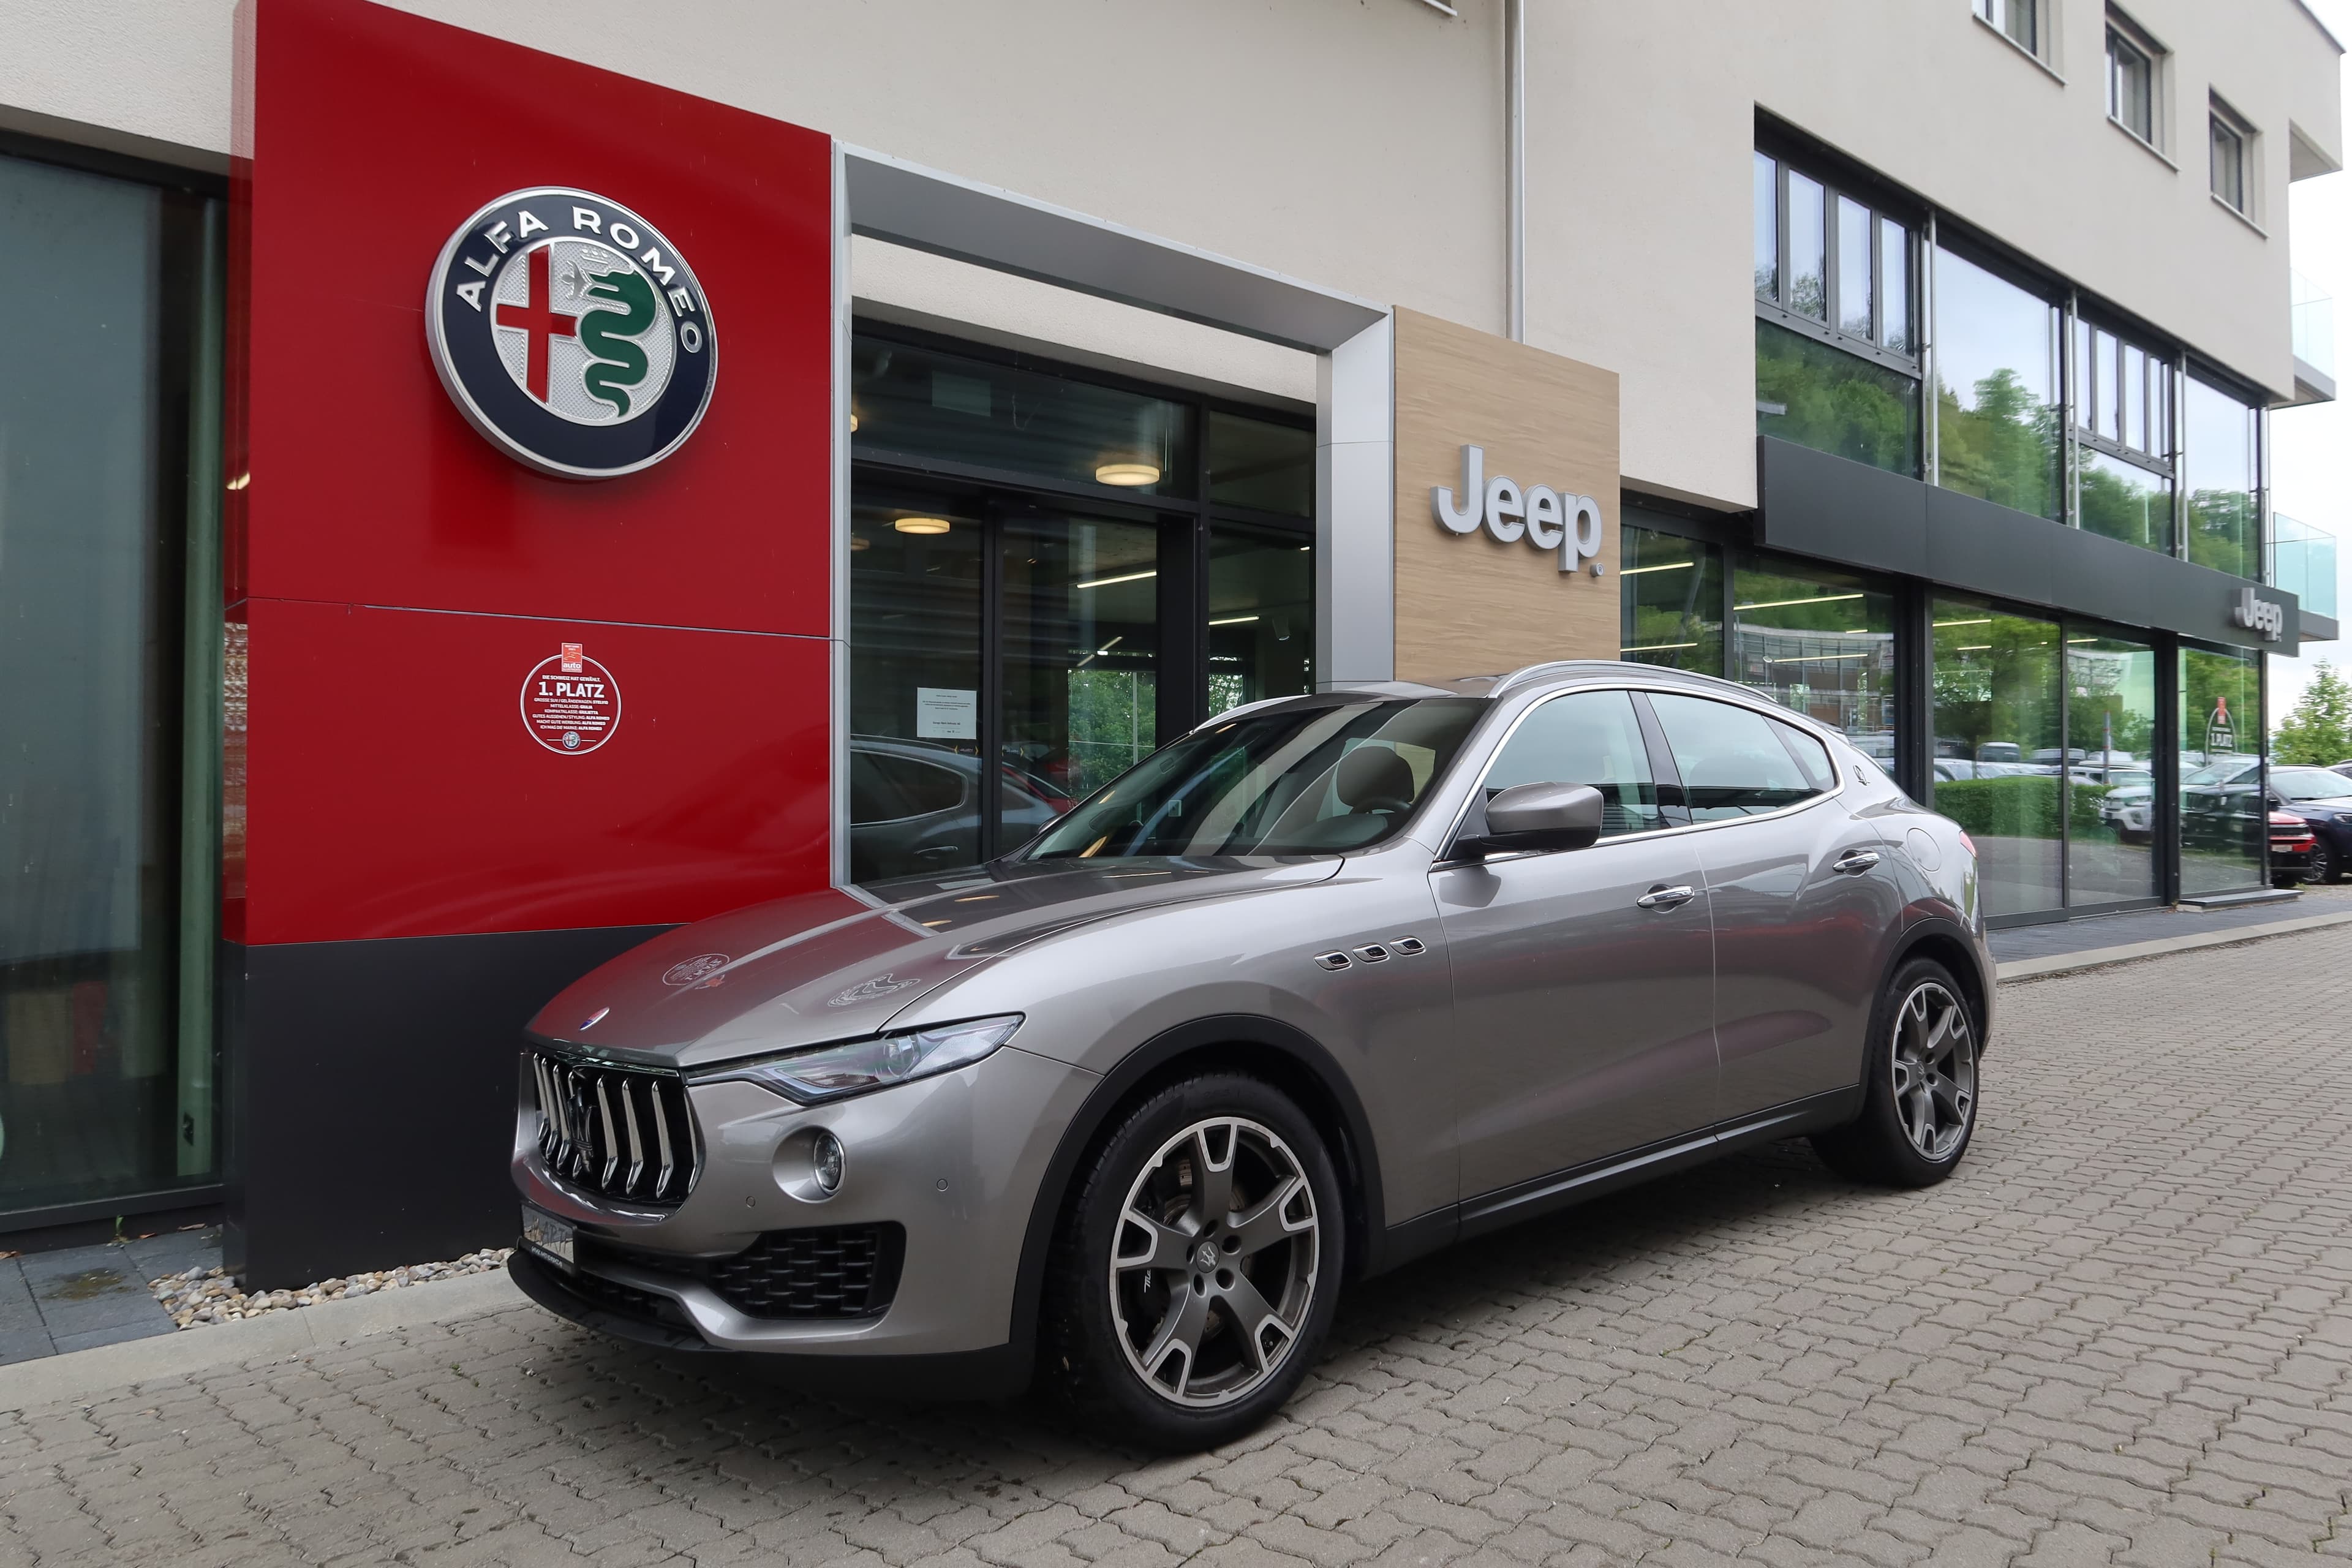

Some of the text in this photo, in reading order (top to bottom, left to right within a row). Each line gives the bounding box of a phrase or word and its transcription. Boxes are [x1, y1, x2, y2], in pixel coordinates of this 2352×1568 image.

[456, 205, 703, 353] ALFA ROMEO
[1430, 444, 1602, 573] Jeep
[2234, 587, 2283, 641] Jeep
[538, 681, 605, 698] 1. PLATZ
